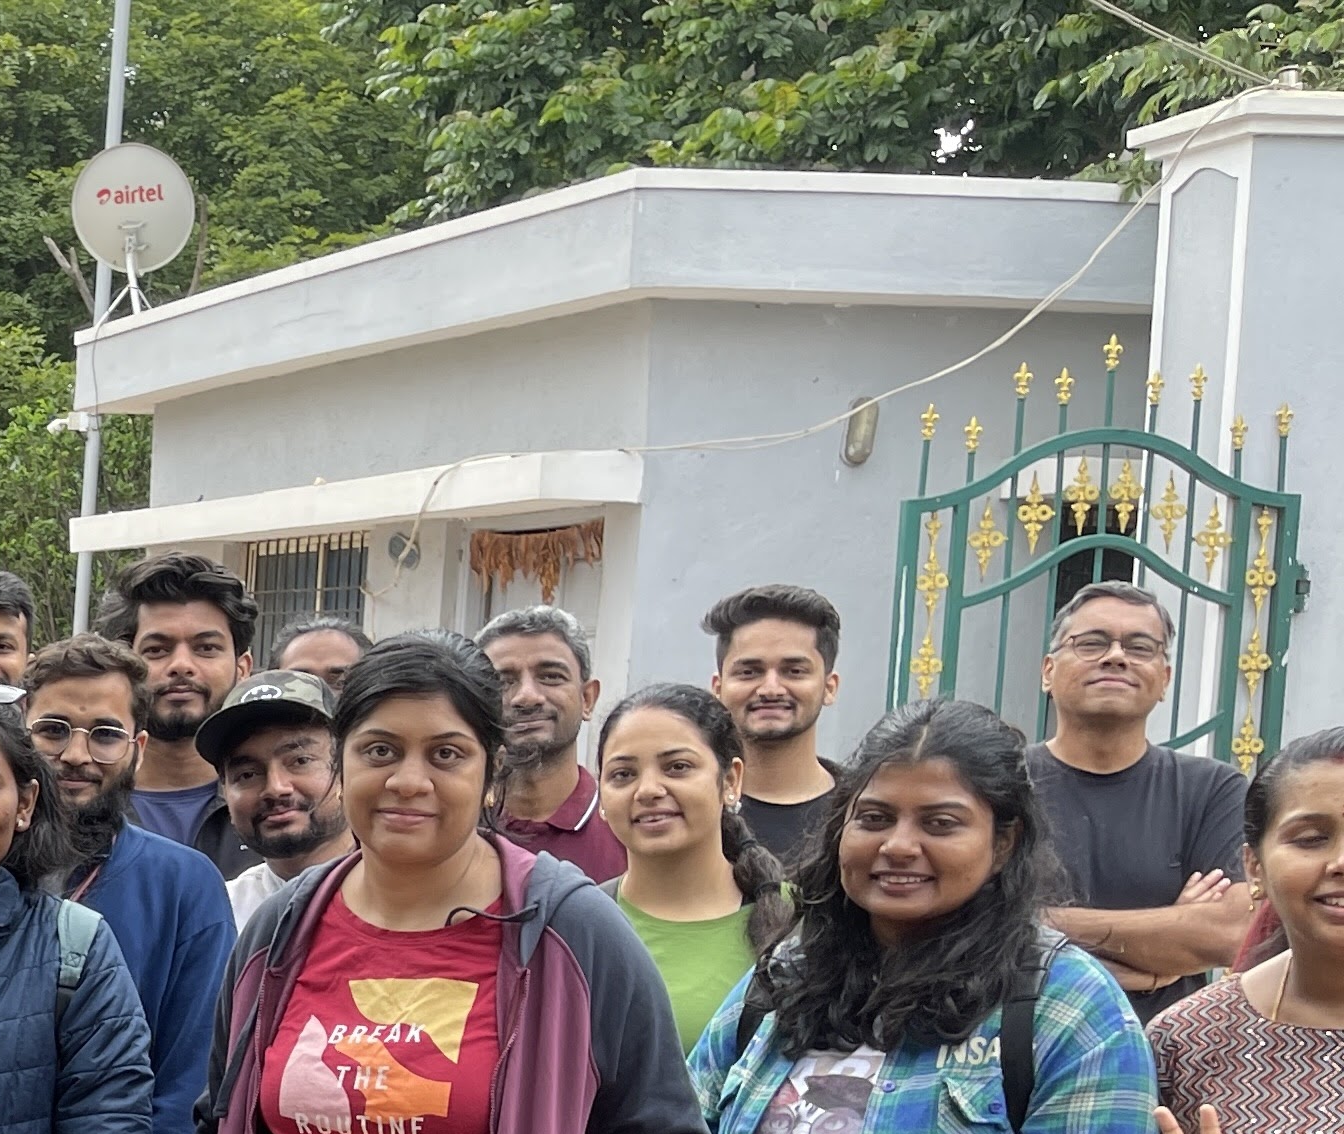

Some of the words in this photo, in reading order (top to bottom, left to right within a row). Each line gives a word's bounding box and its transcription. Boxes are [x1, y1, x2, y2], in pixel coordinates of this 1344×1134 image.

[114, 184, 164, 205] airtel
[327, 1022, 427, 1045] BREAK
[336, 1065, 391, 1091] THE
